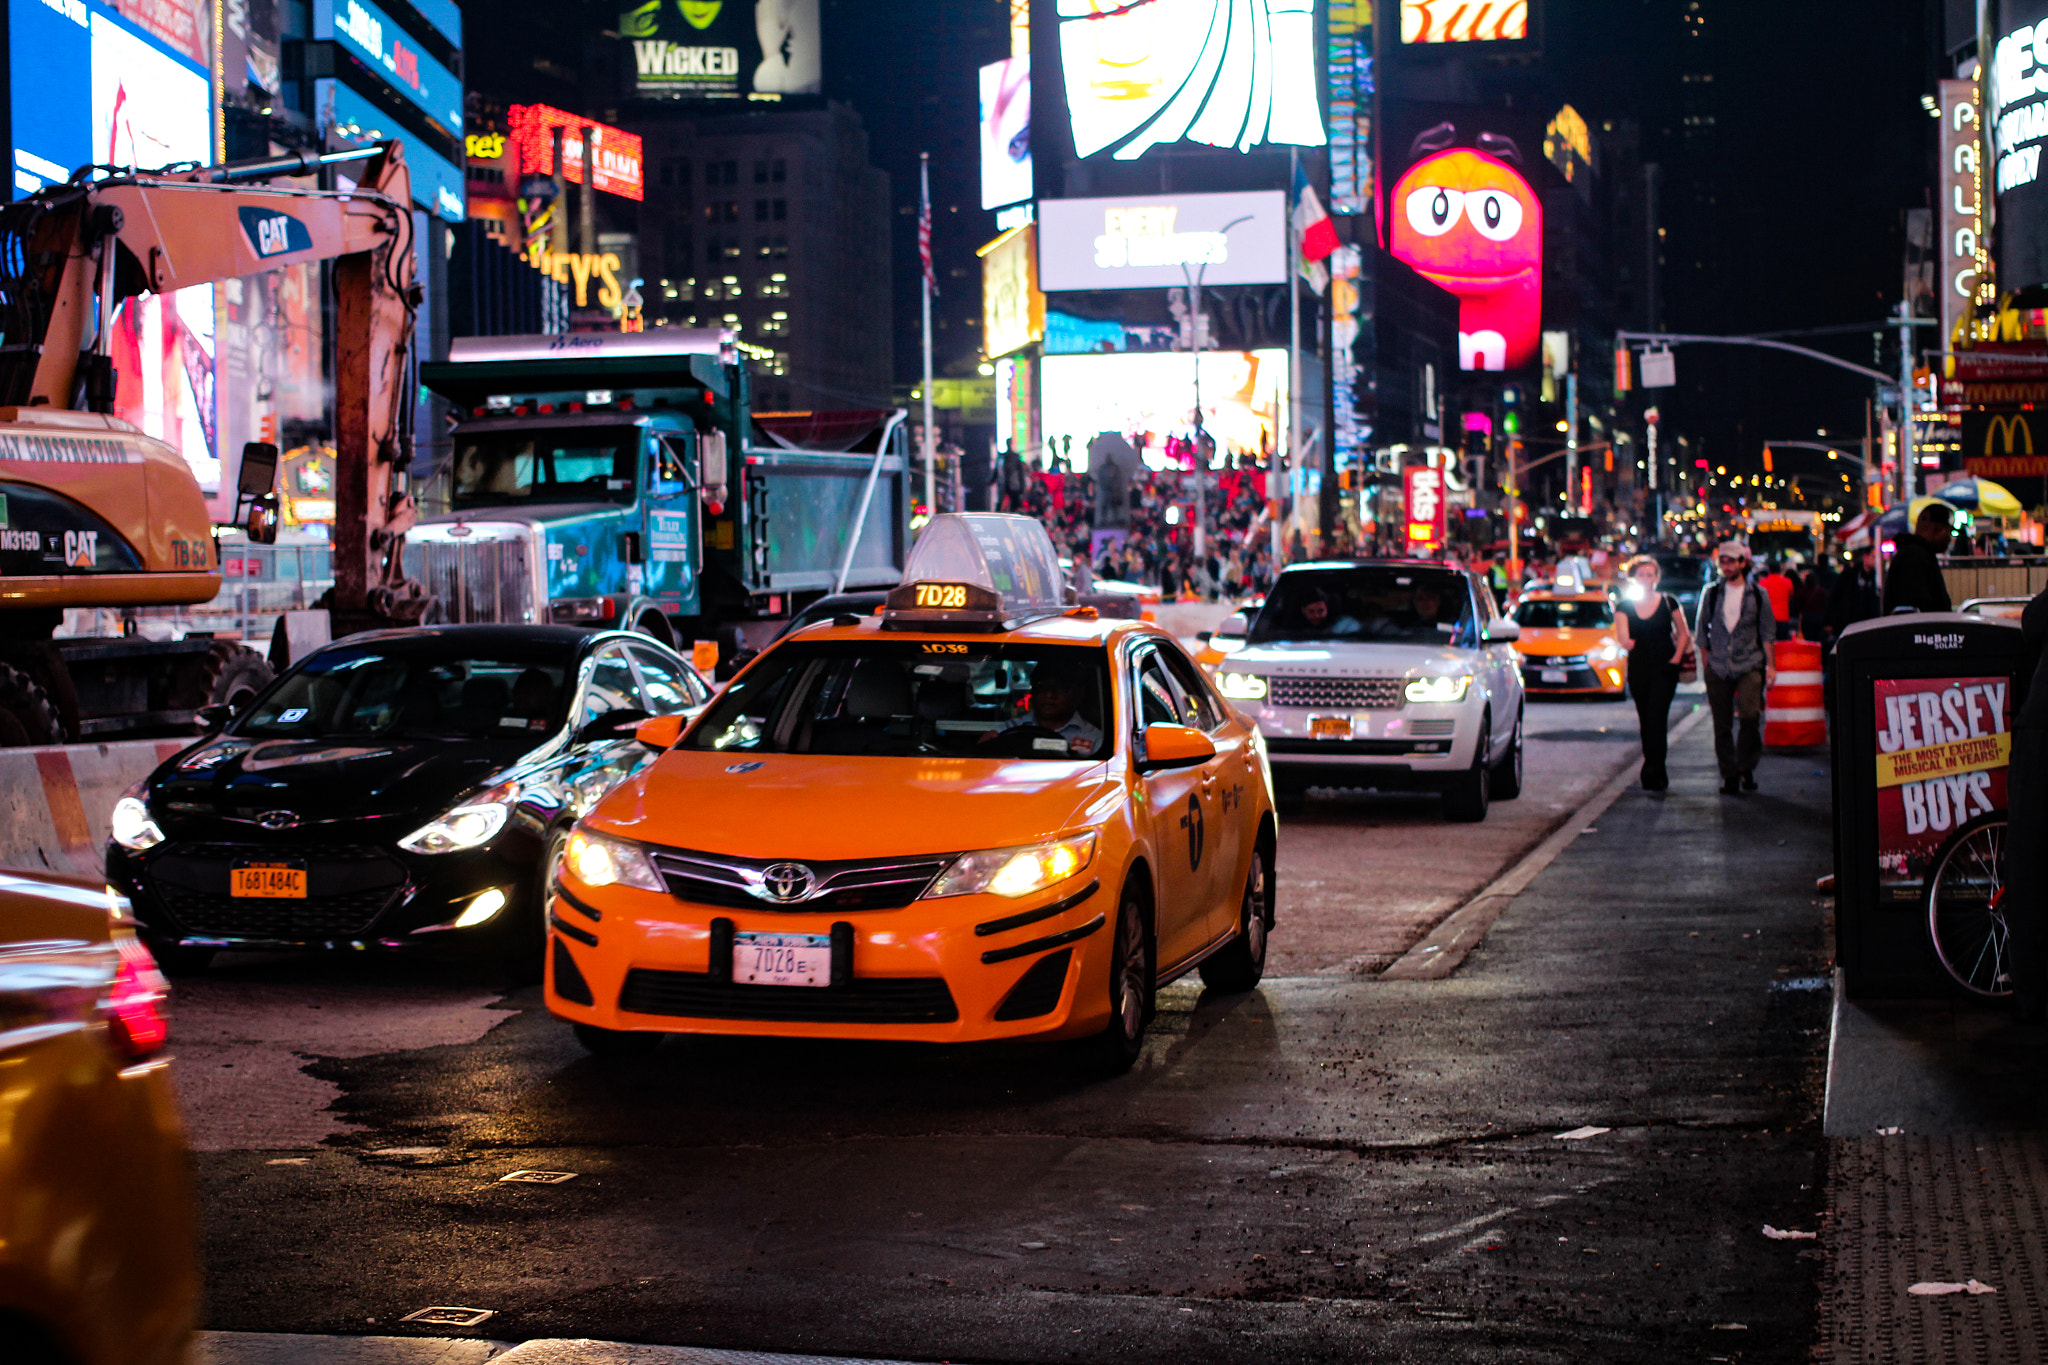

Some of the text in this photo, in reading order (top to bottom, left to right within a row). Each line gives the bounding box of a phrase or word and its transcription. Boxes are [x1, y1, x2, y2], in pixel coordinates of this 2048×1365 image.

[258, 215, 289, 255] CAT
[568, 336, 604, 347] Aero
[25, 436, 128, 463] CONSTRUCTION
[0, 530, 40, 551] M315D
[64, 530, 98, 567] CAT
[171, 540, 207, 565] TB 53
[915, 585, 967, 607] 7D28
[1914, 634, 1965, 645] BigBelly
[1878, 682, 2006, 753] JERSEY
[1915, 746, 1946, 760] MOST
[1948, 738, 1998, 754] EXCITING
[1894, 760, 1944, 778] MUSICAL
[1945, 757, 1958, 768] IN
[1902, 771, 1994, 835] BOYS
[238, 871, 300, 890] T681484C
